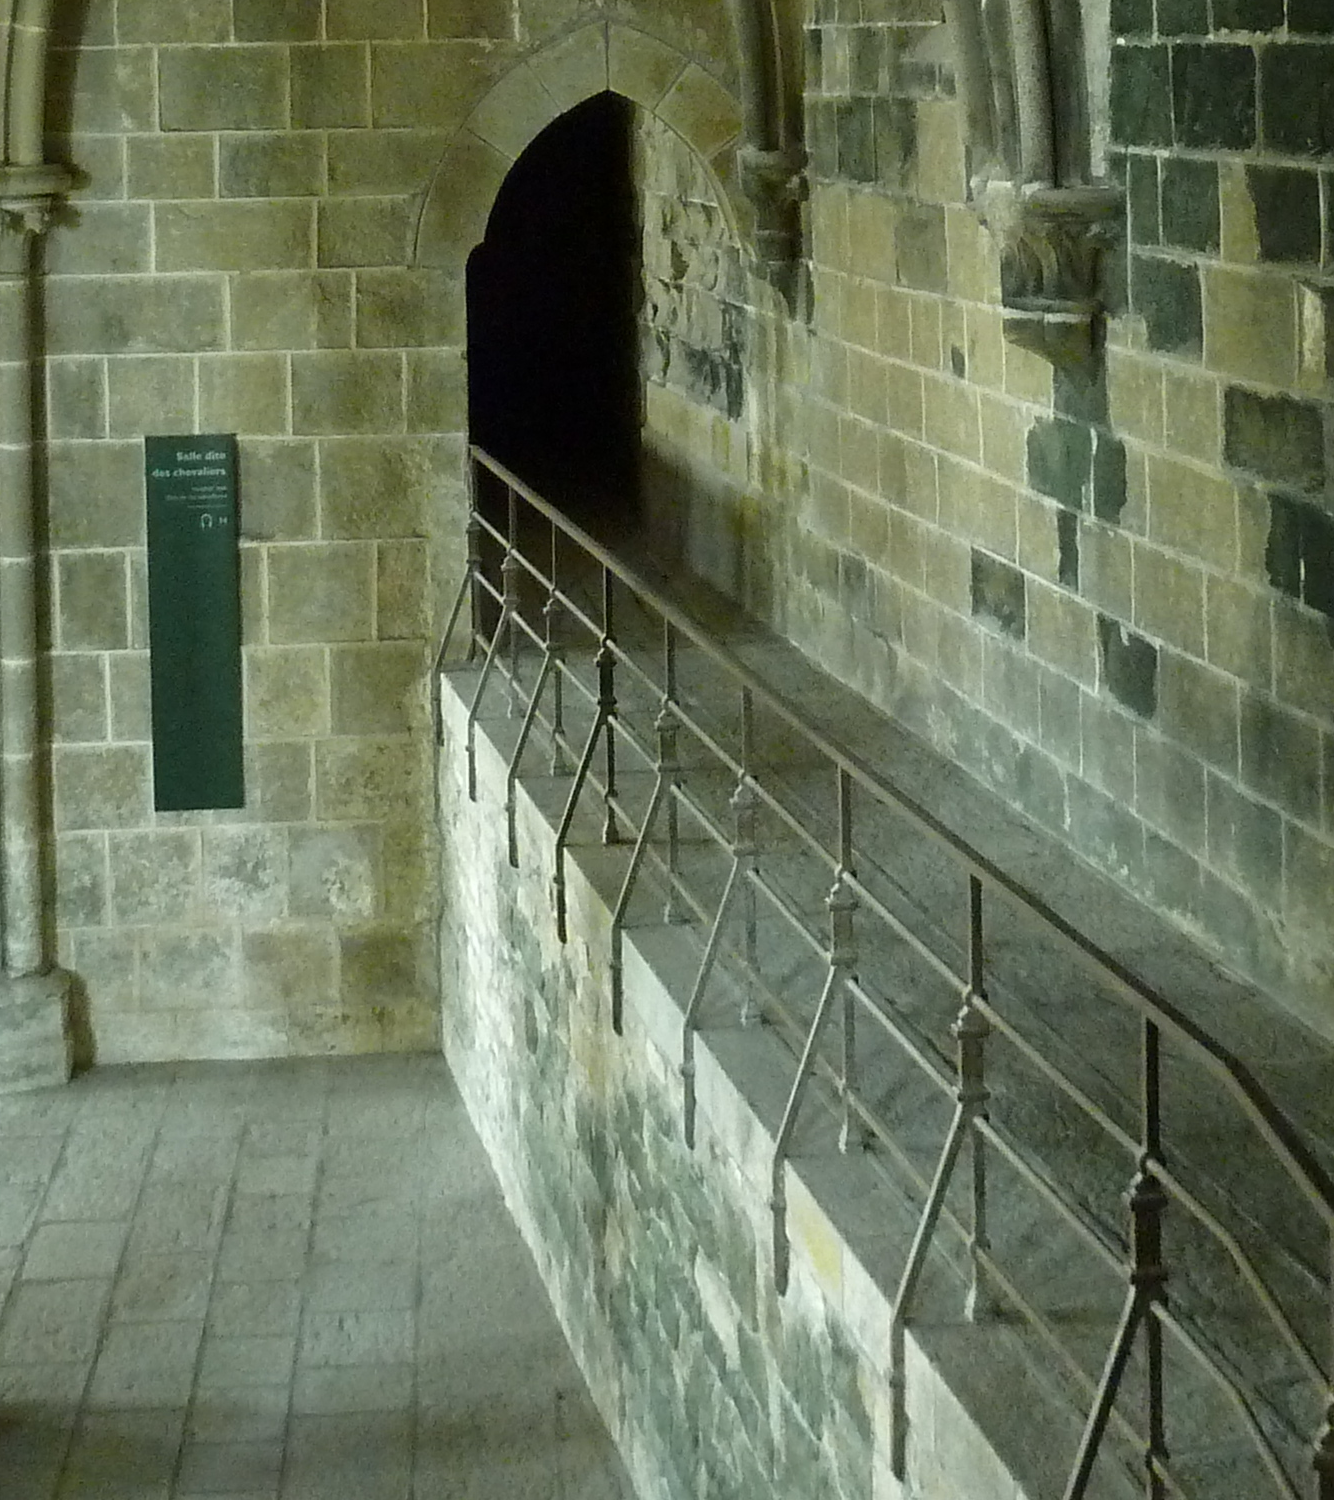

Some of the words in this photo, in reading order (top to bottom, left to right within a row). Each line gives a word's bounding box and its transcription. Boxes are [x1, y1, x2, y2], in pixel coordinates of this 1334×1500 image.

[176, 451, 201, 461] Salle
[152, 469, 170, 477] des
[173, 466, 226, 476] chevaliers
